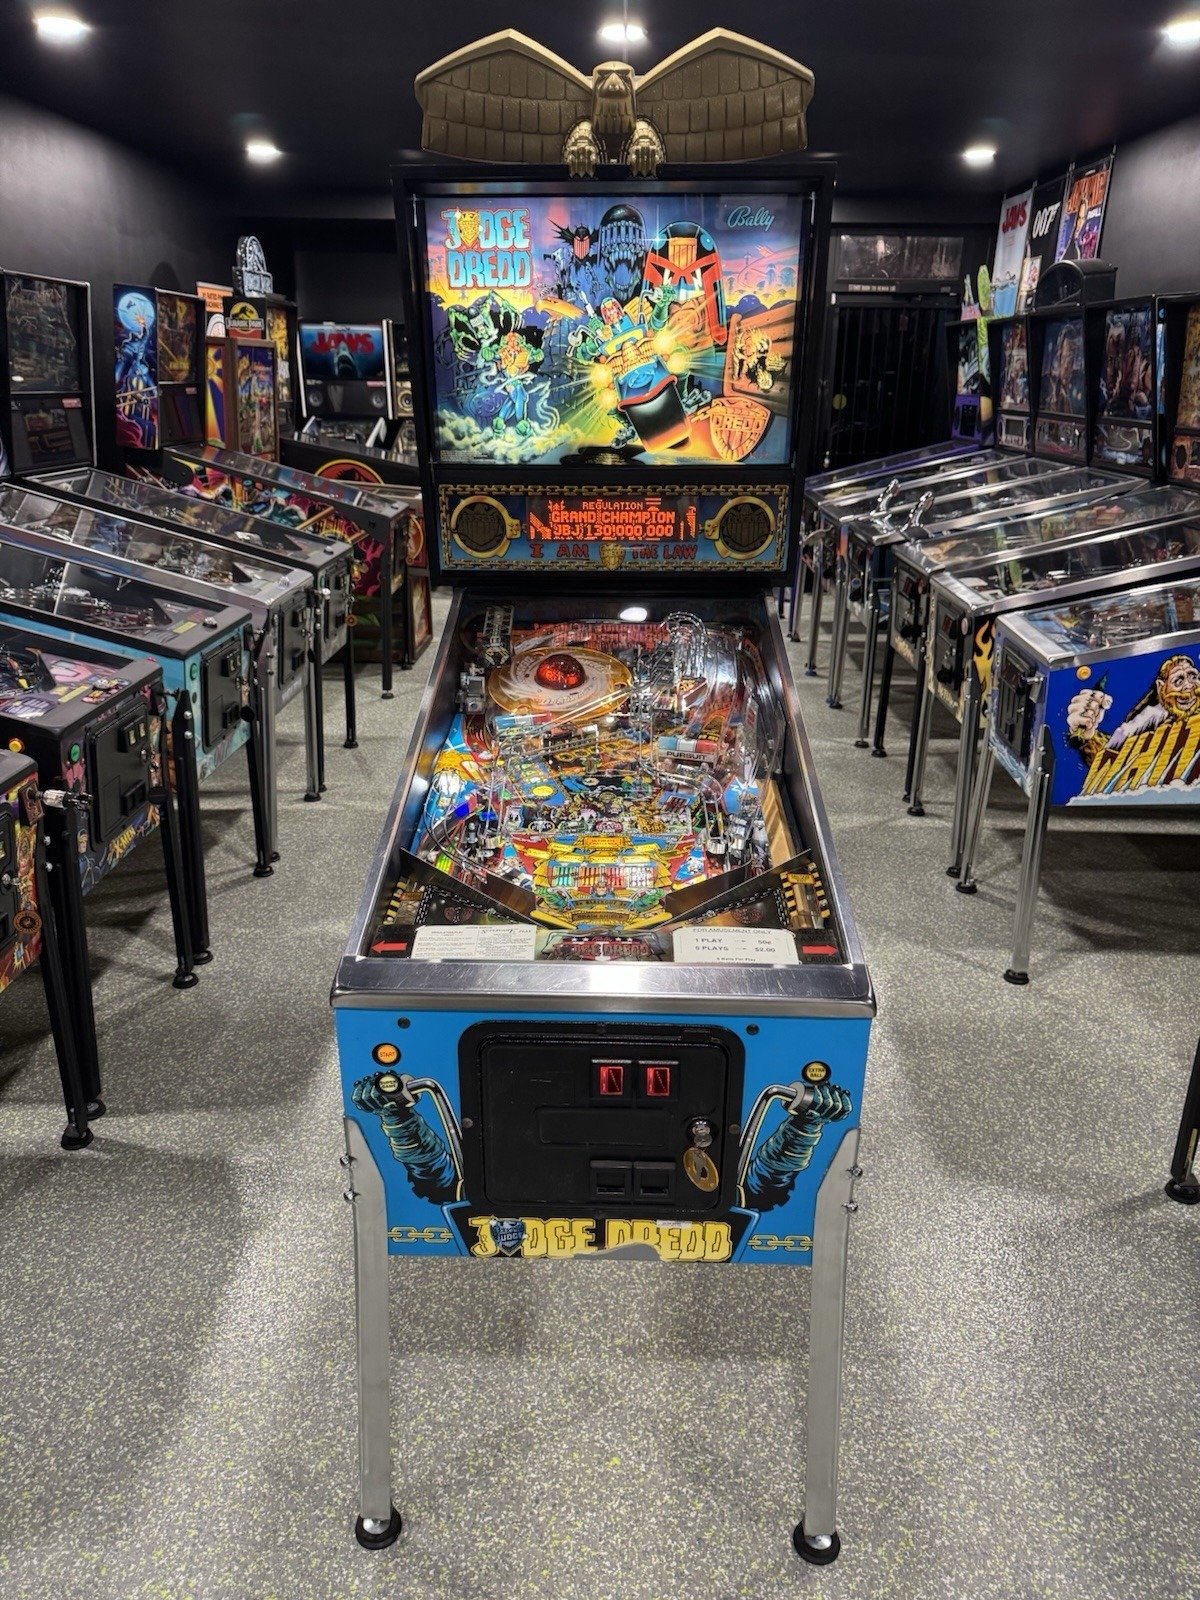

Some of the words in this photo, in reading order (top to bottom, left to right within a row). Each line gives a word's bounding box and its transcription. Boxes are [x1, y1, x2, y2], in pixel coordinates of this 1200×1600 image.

[728, 205, 775, 231] Bally
[1002, 200, 1028, 234] JAWS
[1032, 201, 1061, 239] 007
[441, 208, 530, 250] JDGE
[447, 250, 531, 288] DREDD
[313, 332, 374, 353] JAWS
[711, 413, 766, 431] DREDD
[551, 511, 596, 523] GRAND
[600, 511, 676, 523] CHAMPION
[582, 501, 644, 510] REGULATION
[529, 543, 545, 559] I
[556, 543, 590, 560] AM
[631, 543, 660, 560] THE
[663, 544, 698, 560] LAW
[666, 751, 707, 760] PURSUIT
[468, 1216, 599, 1258] JDGE
